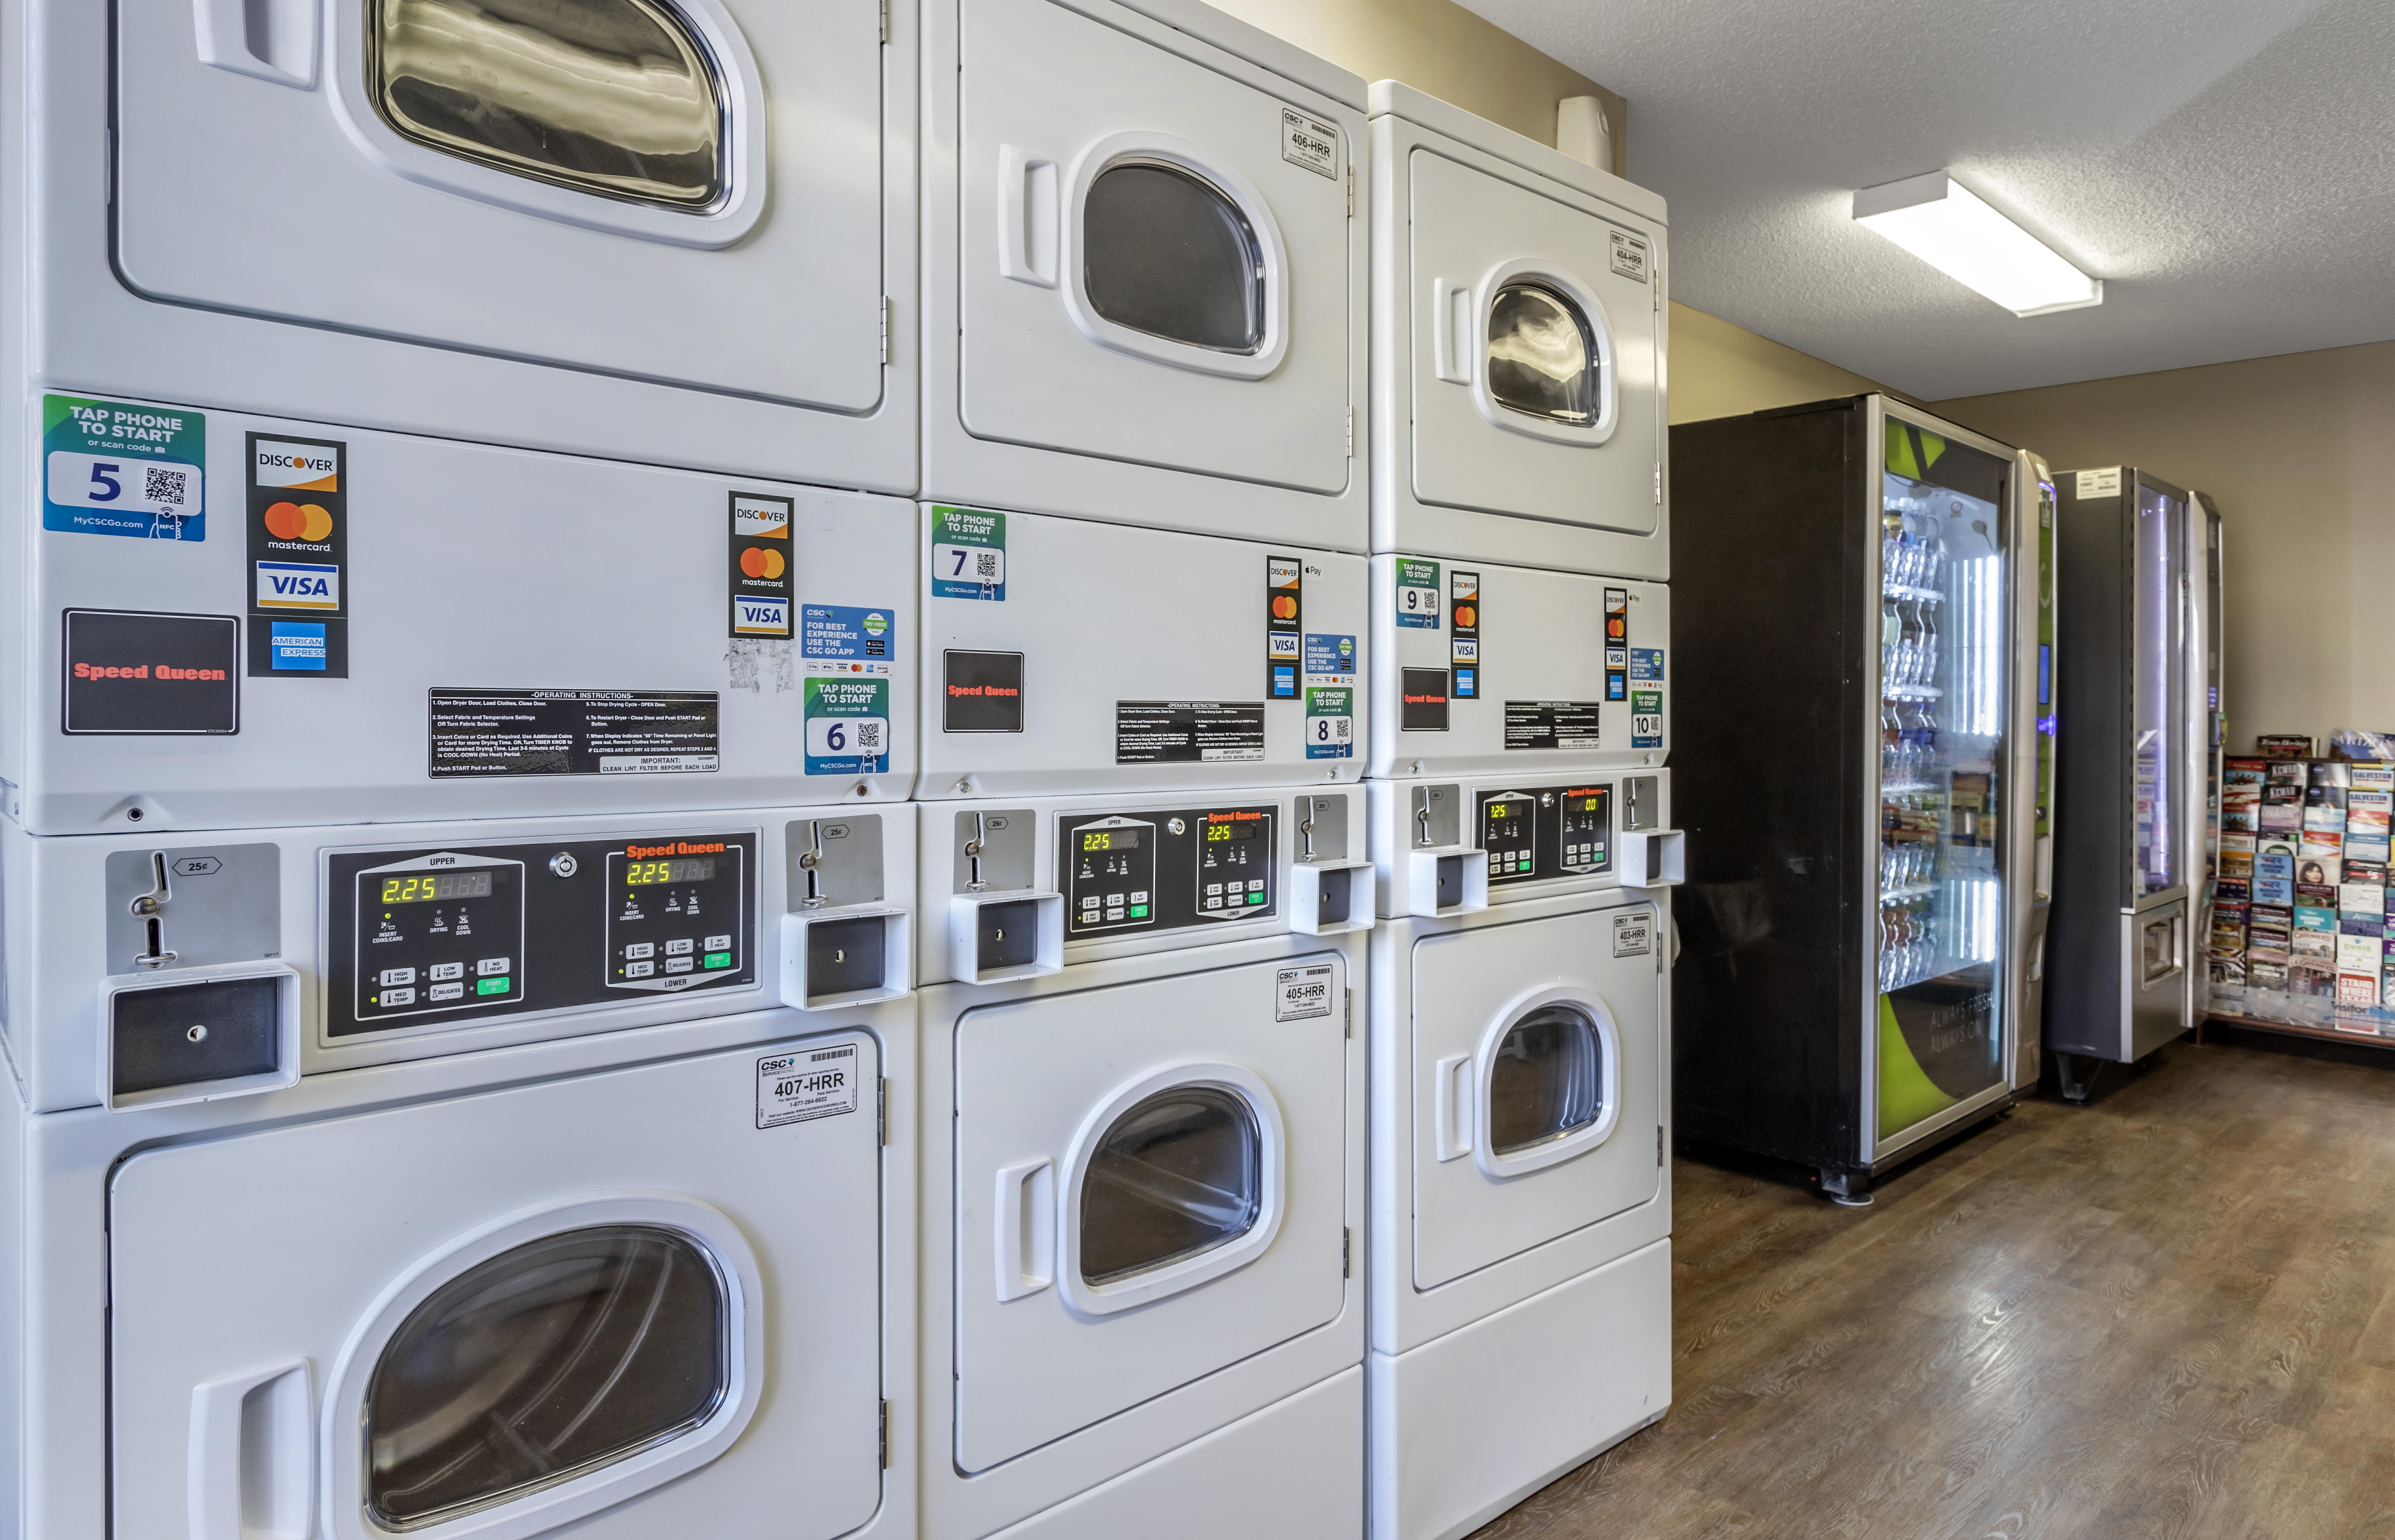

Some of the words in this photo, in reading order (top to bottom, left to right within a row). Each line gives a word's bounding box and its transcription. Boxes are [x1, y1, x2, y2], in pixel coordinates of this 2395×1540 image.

[1285, 113, 1298, 122] CSC
[1292, 133, 1330, 158] 406-HRR
[1617, 250, 1642, 266] 404-HRR
[70, 406, 109, 420] TAP
[115, 411, 182, 430] PHONE
[79, 421, 106, 435] TO
[112, 425, 174, 443] START
[102, 441, 124, 449] scan
[126, 443, 151, 452] code
[260, 454, 333, 471] DISCOVER
[88, 463, 121, 501] 5
[737, 509, 785, 522] DISCOVER
[944, 513, 961, 522] TAP
[963, 515, 995, 526] PHONE
[74, 517, 143, 528] MyCSCGo.com
[947, 522, 960, 531] TO
[963, 524, 991, 534] START
[952, 550, 966, 575] 7
[1271, 568, 1297, 577] DISCOVER
[1311, 566, 1321, 577] Pay
[1414, 571, 1430, 579] START
[267, 576, 329, 596] VISA
[1408, 591, 1417, 610] 9
[742, 607, 781, 623] VISA
[807, 631, 857, 639] EXPERIENCE
[273, 637, 322, 646] AMERICAN
[1273, 639, 1295, 651] VISA
[1456, 645, 1474, 656] VISA
[1609, 654, 1623, 663] VISA
[74, 663, 148, 681] Speed
[155, 665, 225, 680] Queen
[818, 684, 838, 693] TAP
[841, 685, 876, 693] PHONE
[948, 685, 982, 696] Speed
[985, 686, 1017, 696] Queen
[823, 695, 837, 703] TO
[839, 695, 872, 703] START
[1404, 694, 1424, 703] Speed
[1426, 695, 1445, 703] Queen
[1318, 720, 1328, 741] 8
[1636, 717, 1648, 733] 10
[827, 723, 845, 751] 6
[1586, 799, 1596, 810] 00
[1208, 812, 1234, 823] Speed
[1236, 812, 1261, 820] Queen
[1208, 826, 1229, 840] 2.25
[1084, 834, 1109, 850] 2.25
[627, 843, 675, 859] Speed
[677, 843, 724, 854] Queen
[189, 863, 208, 871] 25¢
[430, 858, 455, 866] UPPER
[628, 863, 668, 884] 2.25
[383, 878, 434, 901] 2.25
[1620, 929, 1645, 940] 403-HRR
[2344, 943, 2371, 952] ENNIS
[665, 979, 687, 987] LOWER
[2340, 978, 2373, 988] STAND
[1287, 985, 1325, 999] 405-HRR
[2340, 986, 2372, 997] WHERE
[2331, 1001, 2368, 1013] visitor
[1931, 1002, 1965, 1027] ALWAYS
[1931, 1026, 1965, 1053] ALWAYS
[761, 1059, 786, 1071] CSC
[775, 1073, 844, 1097] 407-HRR
[790, 1097, 827, 1107] 1-877-264-6622
